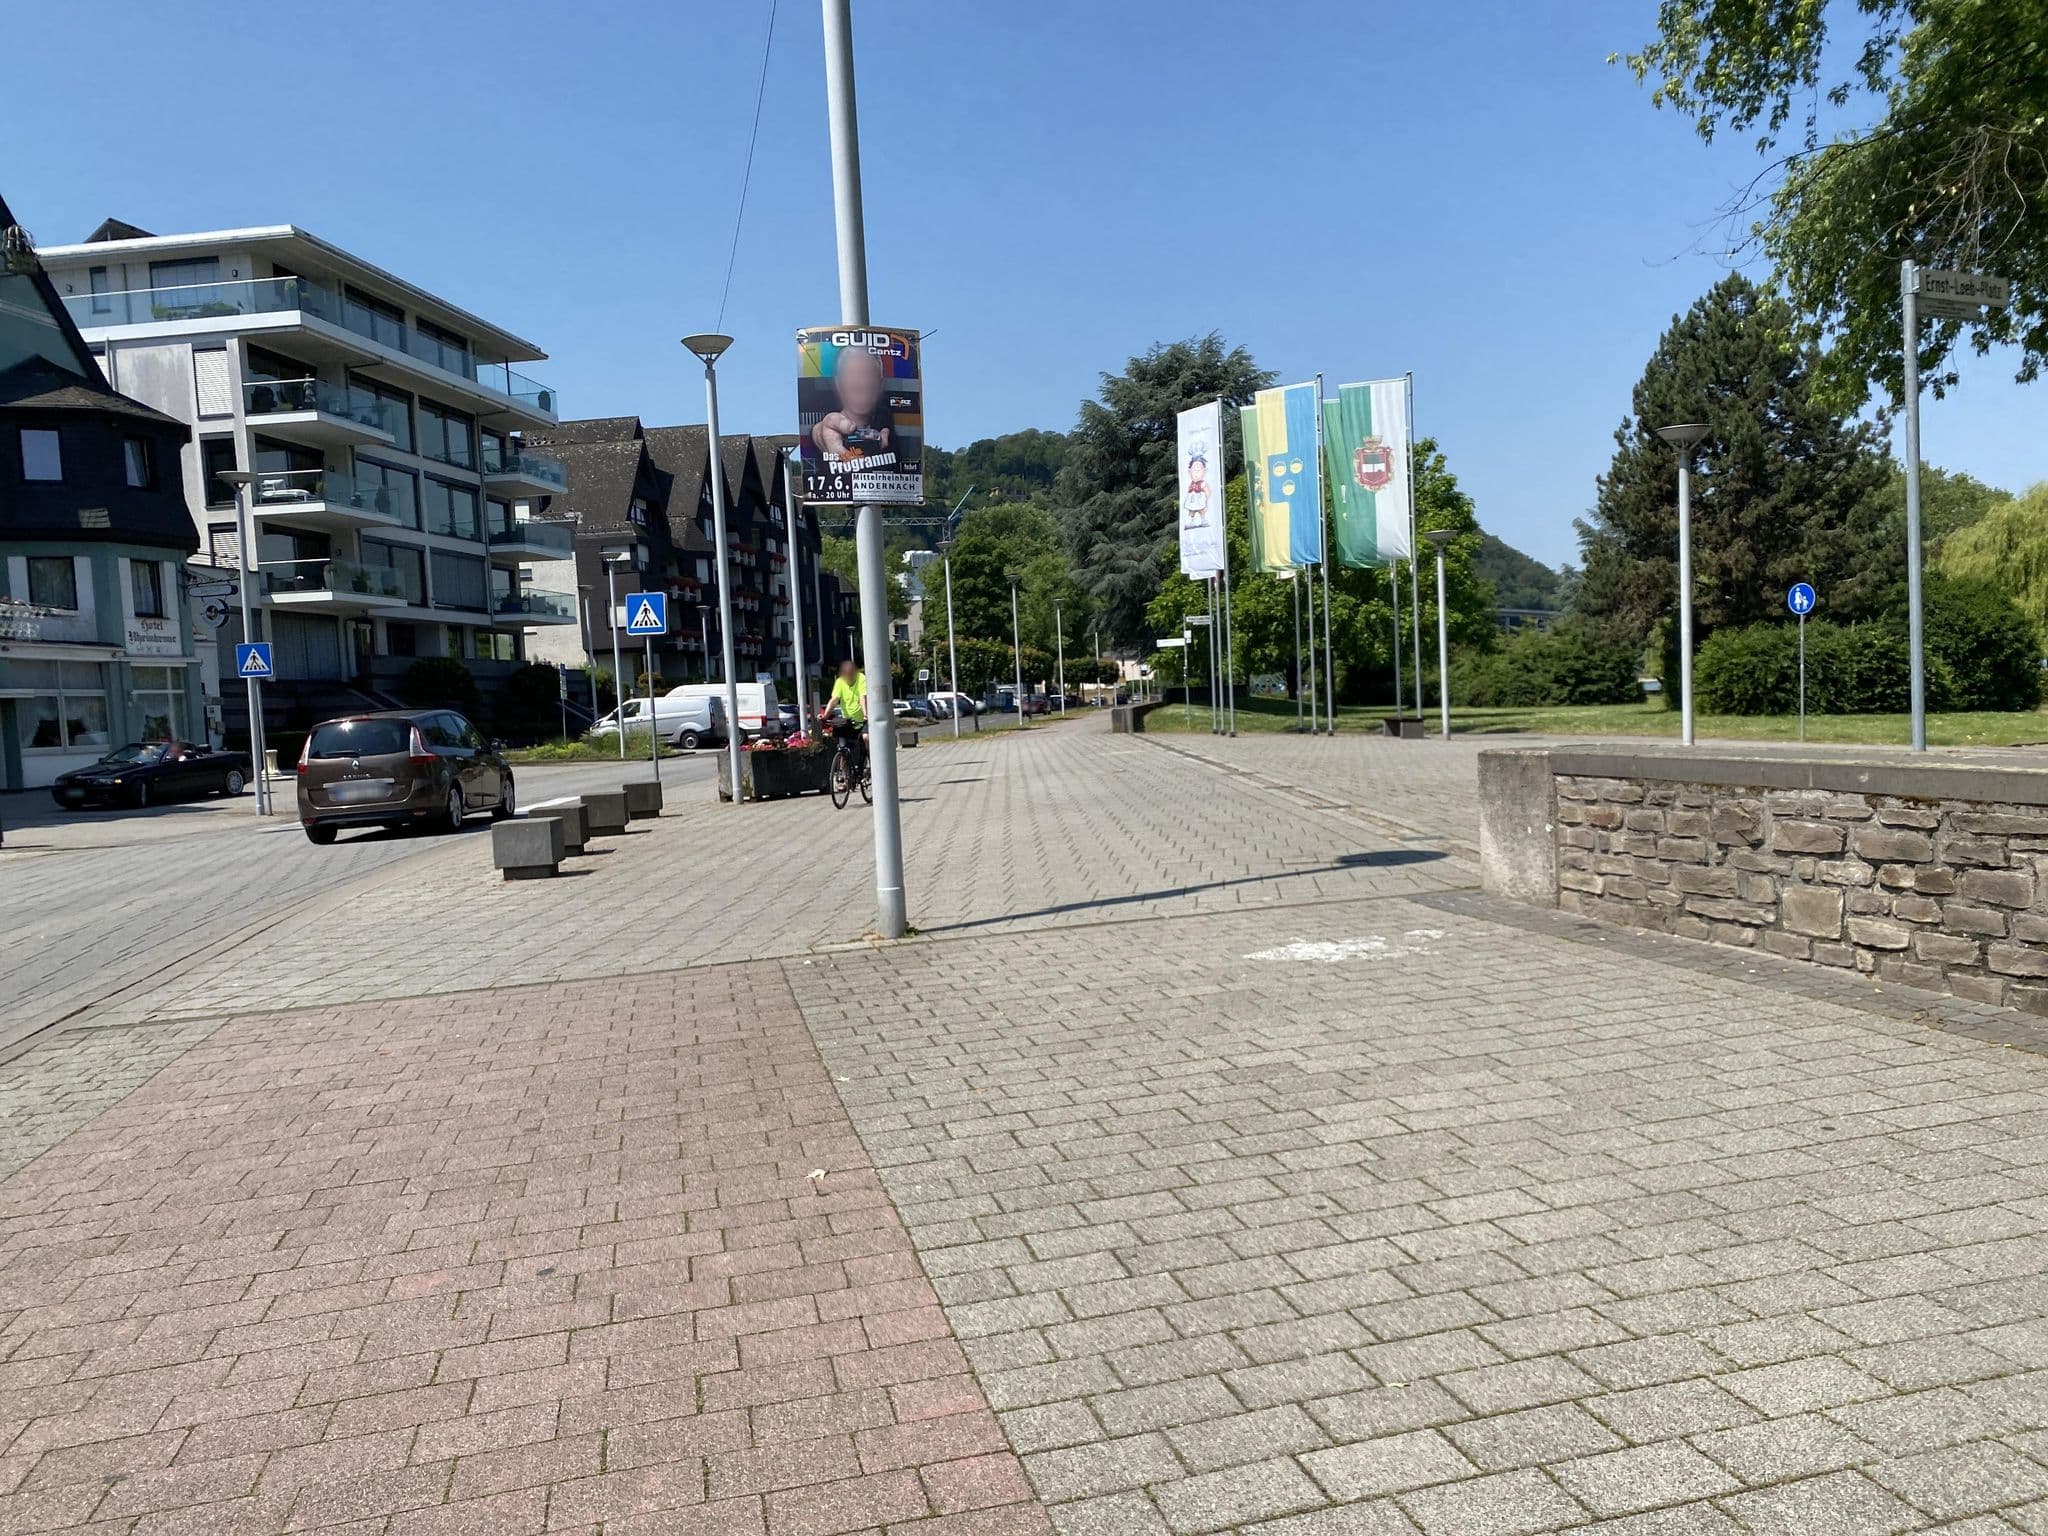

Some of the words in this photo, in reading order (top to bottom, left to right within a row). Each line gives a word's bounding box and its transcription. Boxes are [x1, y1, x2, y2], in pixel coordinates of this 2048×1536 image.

[868, 347, 902, 356] Cantz
[823, 452, 839, 461] Das
[829, 452, 896, 475] Programm
[853, 473, 919, 482] Mittelrheinhalle
[808, 476, 850, 490] 17.6.
[854, 482, 915, 490] ANDERNACH
[826, 491, 835, 499] 20
[836, 491, 850, 499] Uhr
[141, 619, 164, 631] Hotel
